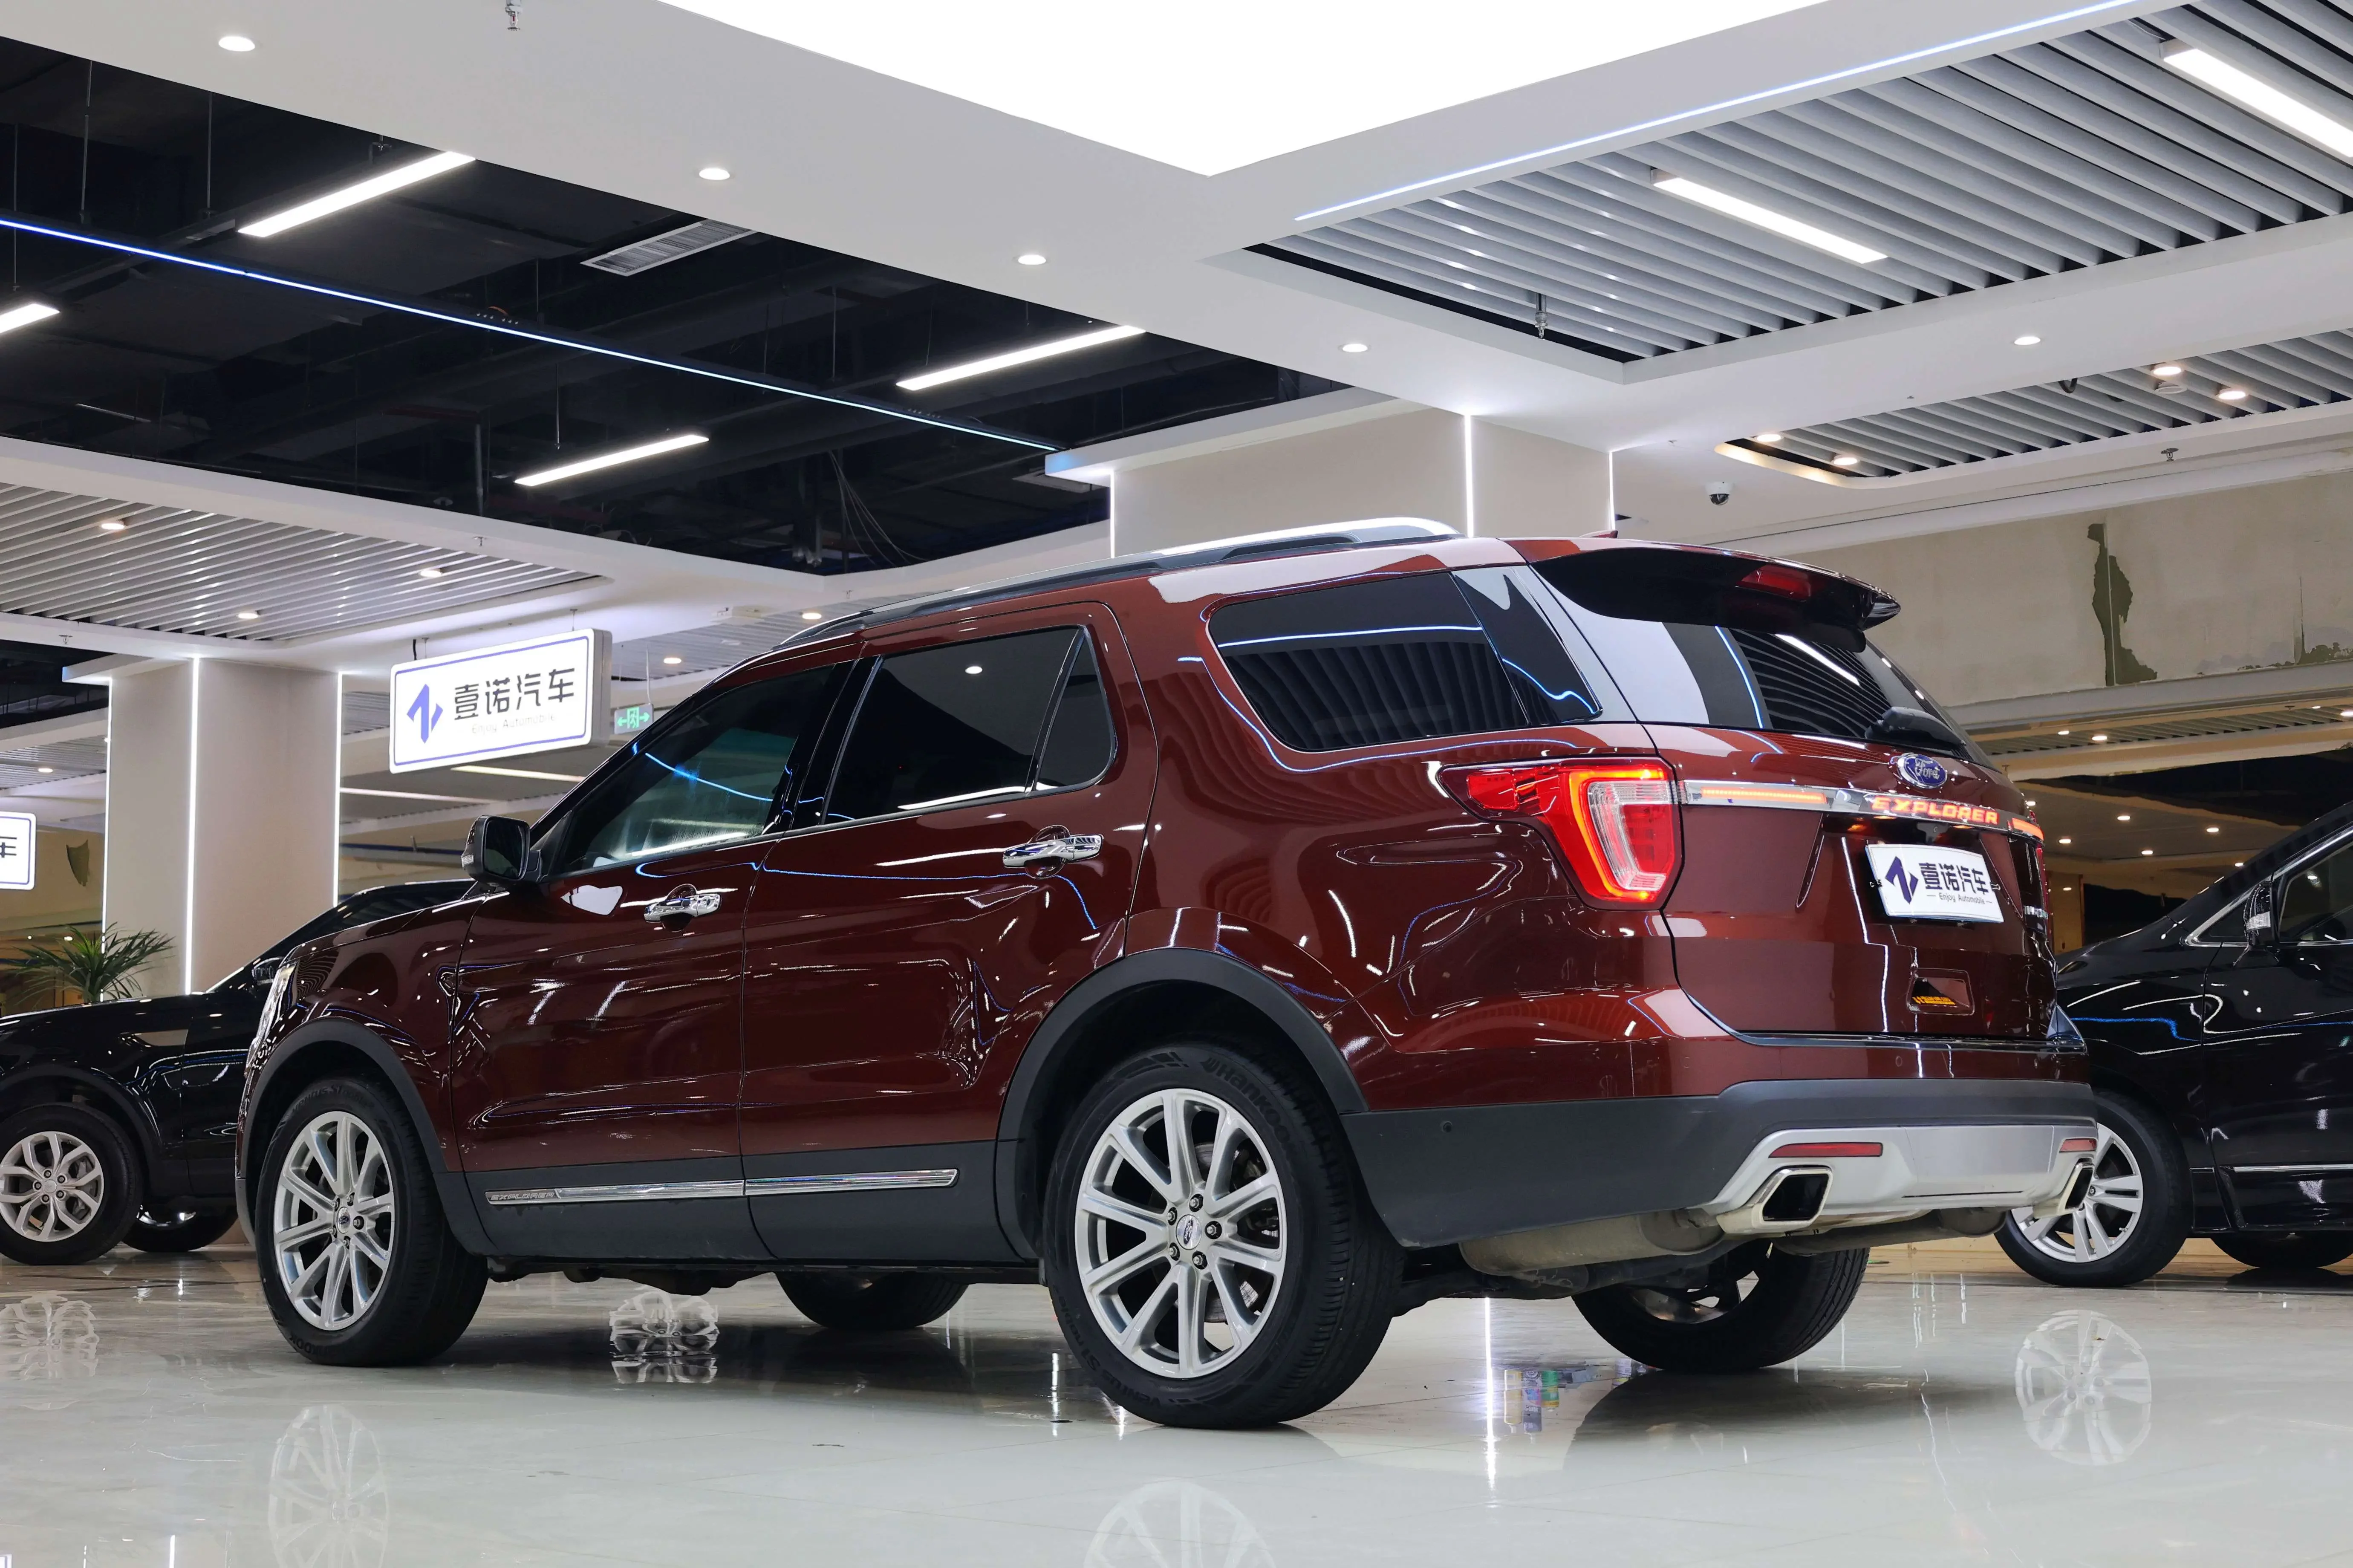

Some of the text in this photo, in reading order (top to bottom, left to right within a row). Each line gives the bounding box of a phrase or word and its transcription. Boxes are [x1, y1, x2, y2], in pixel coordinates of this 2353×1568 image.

[454, 668, 575, 720] 壹诺汽车
[1915, 757, 1940, 780] Ford
[1872, 796, 2000, 824] EXPLORER
[1919, 862, 1989, 895] 壹诺汽车
[1939, 892, 1985, 905] Enjoy Automobile
[491, 1192, 554, 1200] EXPLORER
